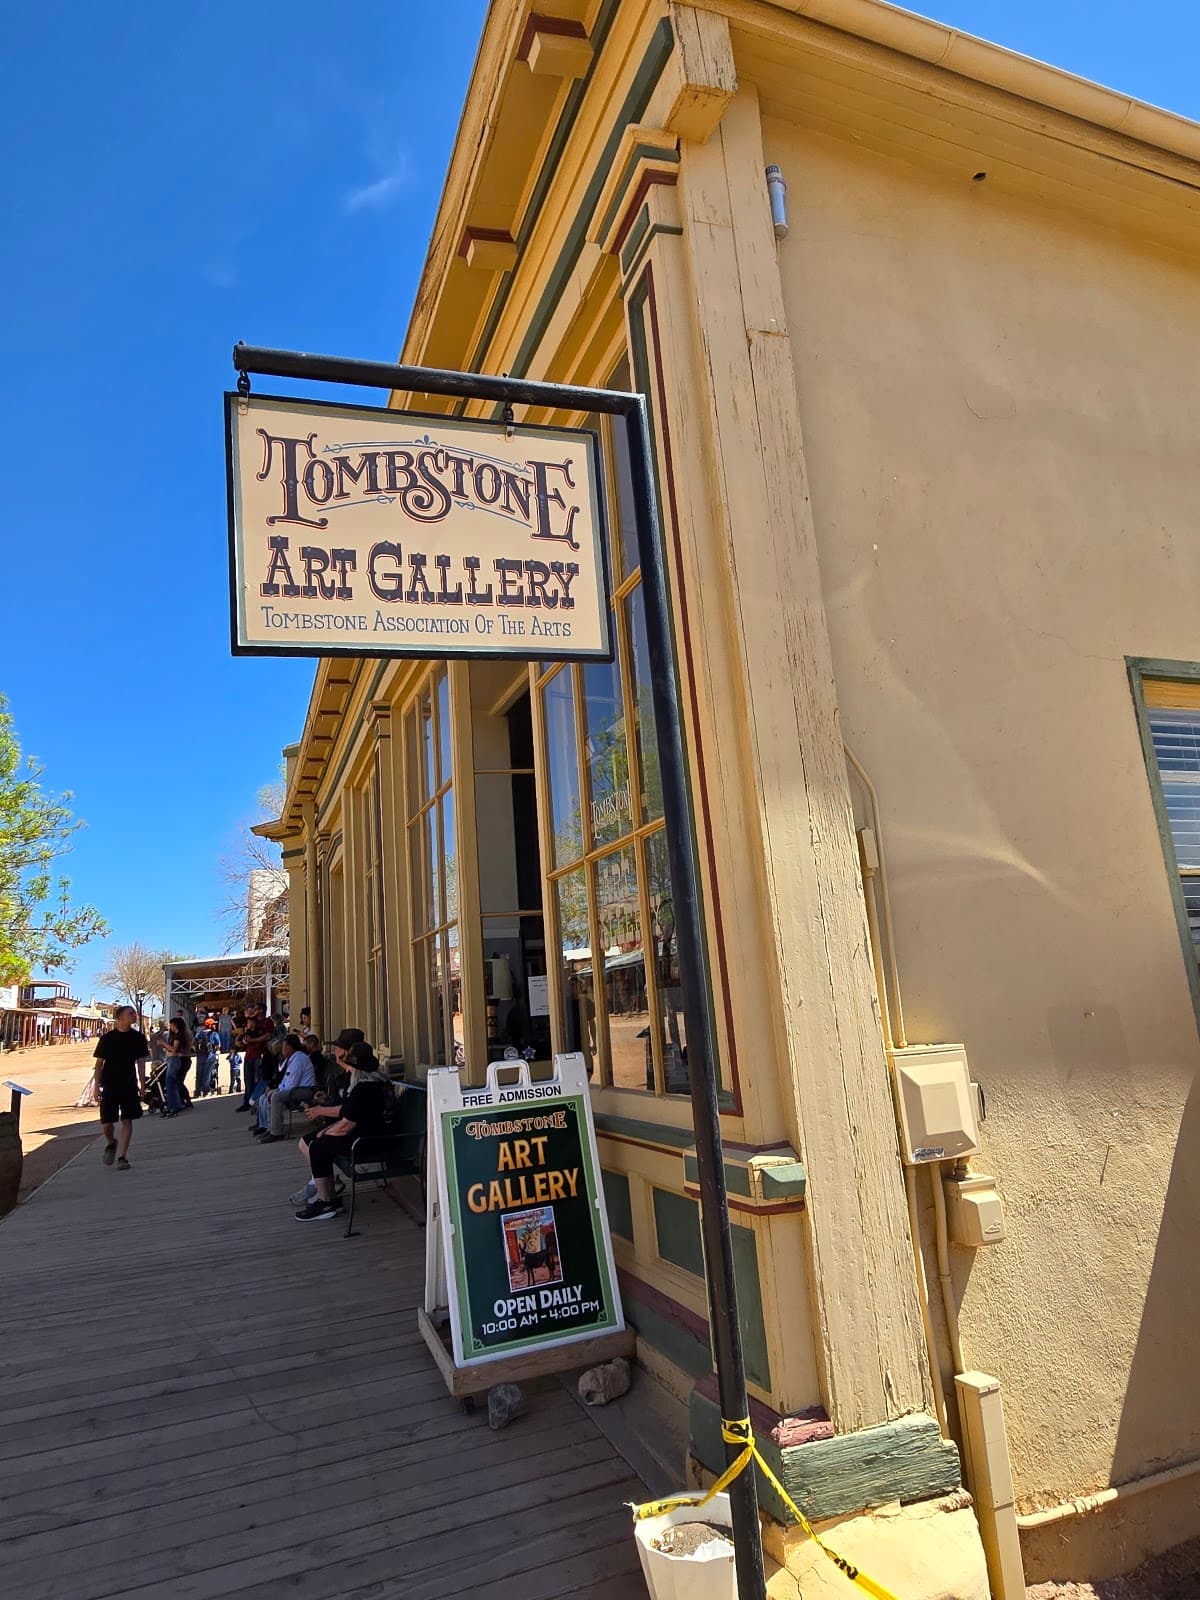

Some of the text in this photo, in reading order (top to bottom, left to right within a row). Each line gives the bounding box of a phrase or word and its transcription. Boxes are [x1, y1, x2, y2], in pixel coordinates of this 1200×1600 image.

[256, 428, 580, 551] TOMBSTONE
[260, 535, 580, 610] ART GALLERY
[261, 606, 572, 637] TOMBSTONE ASSOCIATION OF THE ARTS
[462, 1085, 562, 1107] FREE ADMISSION
[465, 1111, 567, 1140] TOMBSTONE
[497, 1136, 548, 1171] ART
[467, 1168, 579, 1214] GALLERY
[481, 1318, 517, 1336] 10:00
[520, 1313, 539, 1328] AM
[549, 1305, 579, 1320] 4:00
[581, 1300, 600, 1314] PM
[493, 1284, 583, 1318] OPEN DAILY
